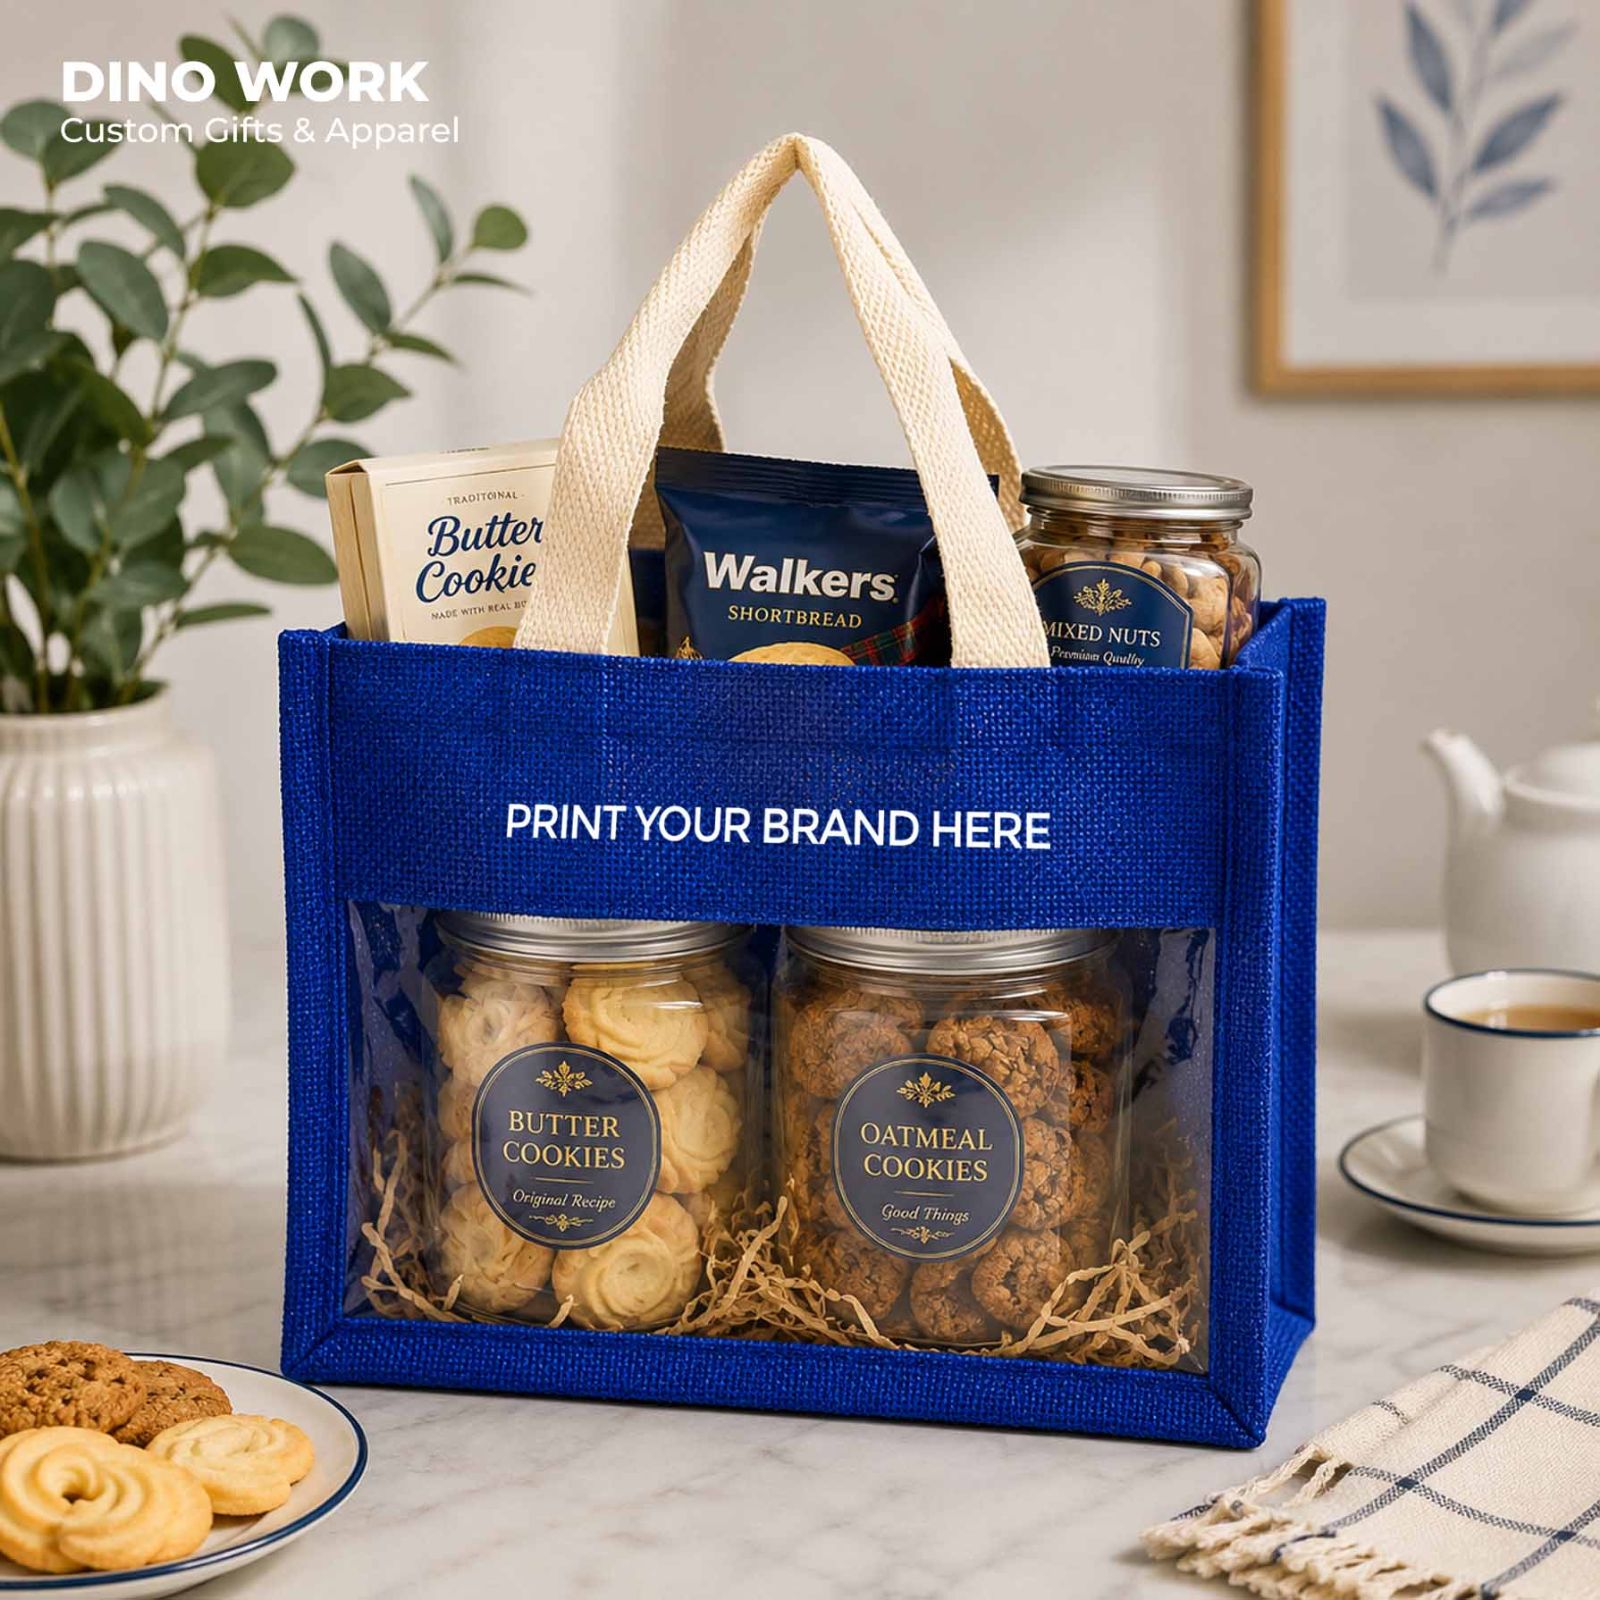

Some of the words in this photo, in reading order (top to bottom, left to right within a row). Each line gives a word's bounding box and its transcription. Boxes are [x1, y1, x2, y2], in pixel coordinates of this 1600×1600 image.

[427, 512, 544, 557] Butter
[703, 551, 896, 601] Walkers
[431, 609, 458, 620] MADE
[460, 606, 485, 616] WITH
[487, 602, 511, 613] REAL
[728, 604, 863, 629] SHORTBREAD
[1042, 620, 1103, 642] MIXED
[1108, 627, 1161, 648] NUTS
[506, 803, 627, 839] PRINT
[635, 804, 751, 843] YOUR
[762, 807, 919, 847] BRAND
[932, 811, 1051, 849] HERE
[508, 1110, 621, 1138] BUTTER
[860, 1122, 993, 1150] OATMEAL
[503, 1141, 625, 1169] COOKIES
[864, 1153, 988, 1182] COOKIES
[513, 1189, 569, 1208] Original
[572, 1194, 616, 1213] Recipe
[881, 1204, 920, 1221] Good
[924, 1207, 970, 1226] Things
